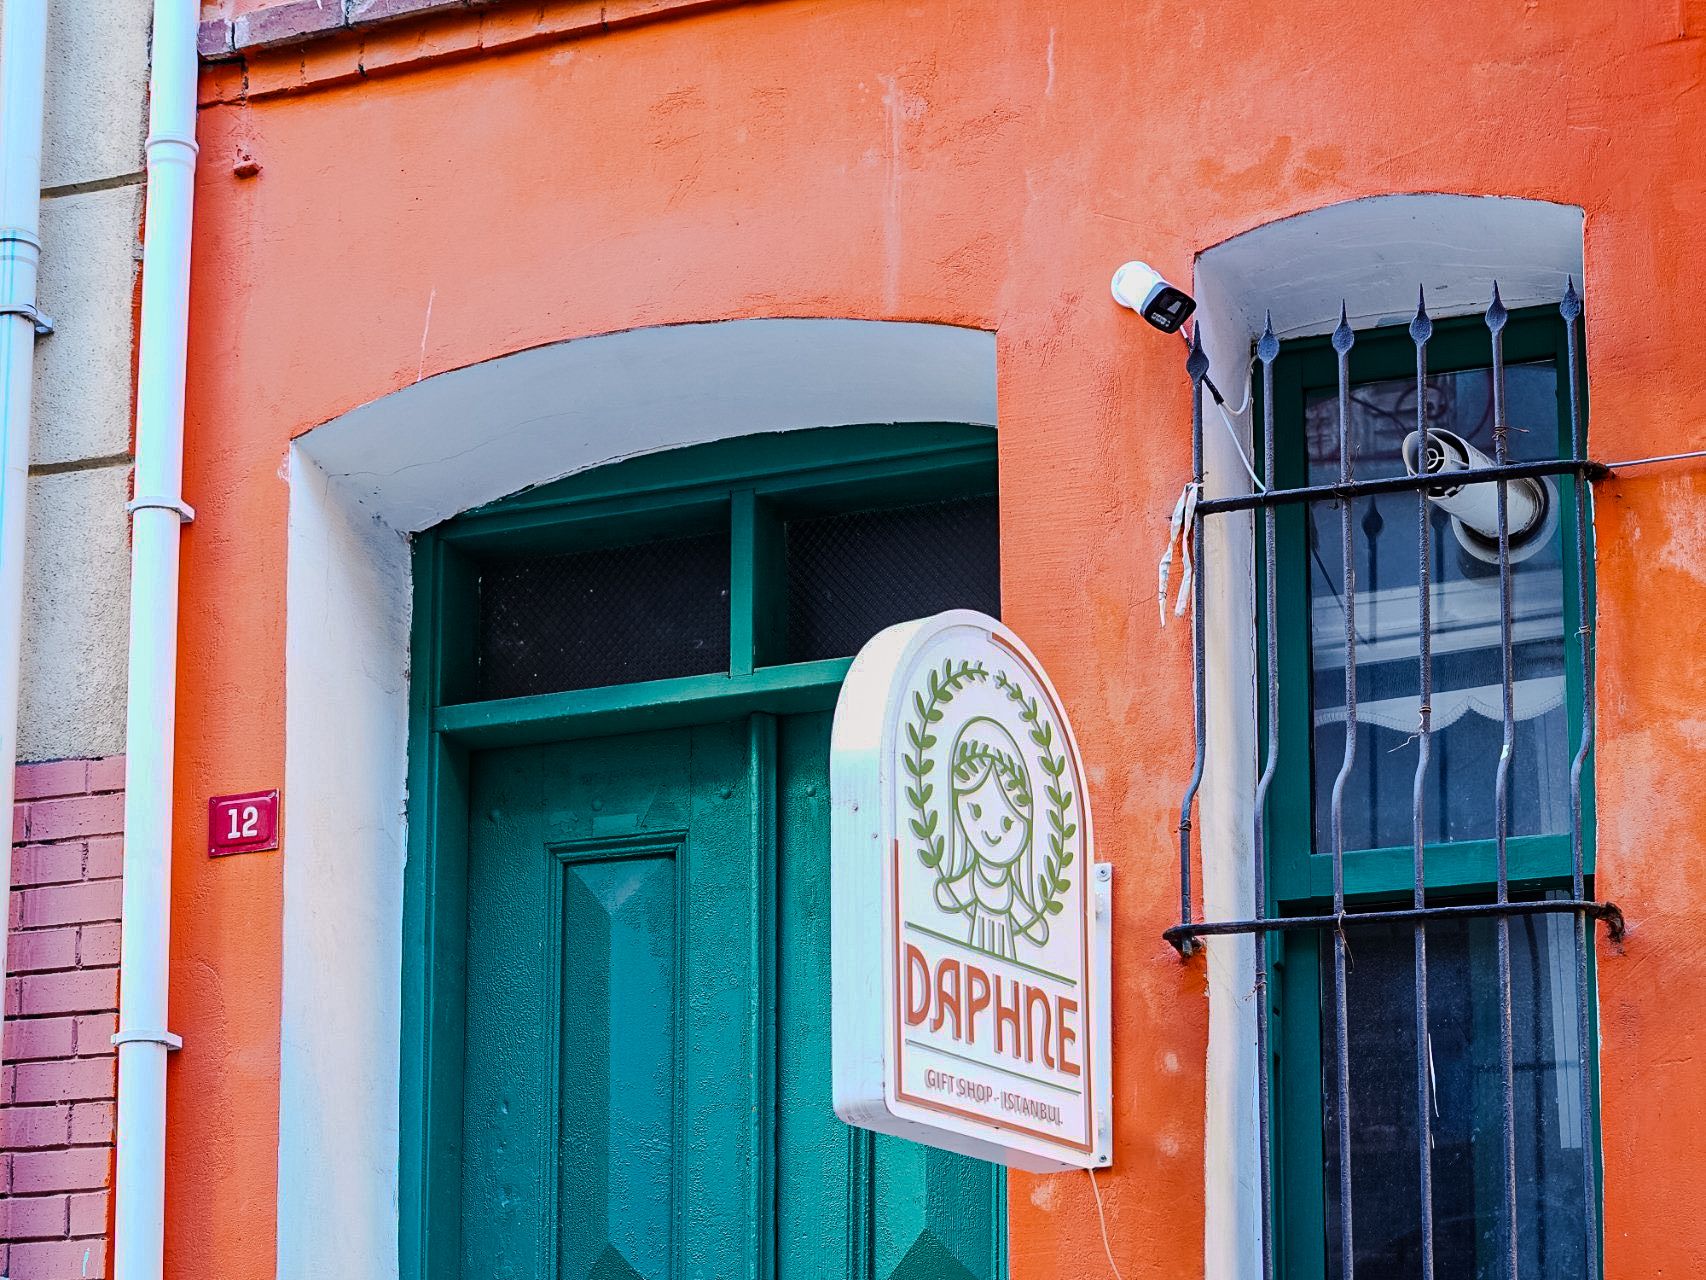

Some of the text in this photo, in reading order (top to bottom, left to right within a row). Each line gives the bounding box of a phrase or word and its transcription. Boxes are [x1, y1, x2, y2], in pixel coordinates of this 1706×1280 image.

[227, 806, 259, 840] 12
[904, 942, 1081, 1077] DAPHNE
[926, 1069, 955, 1093] GIFT
[957, 1078, 993, 1104] SHOP
[1001, 1090, 1064, 1126] ISTANBUL
